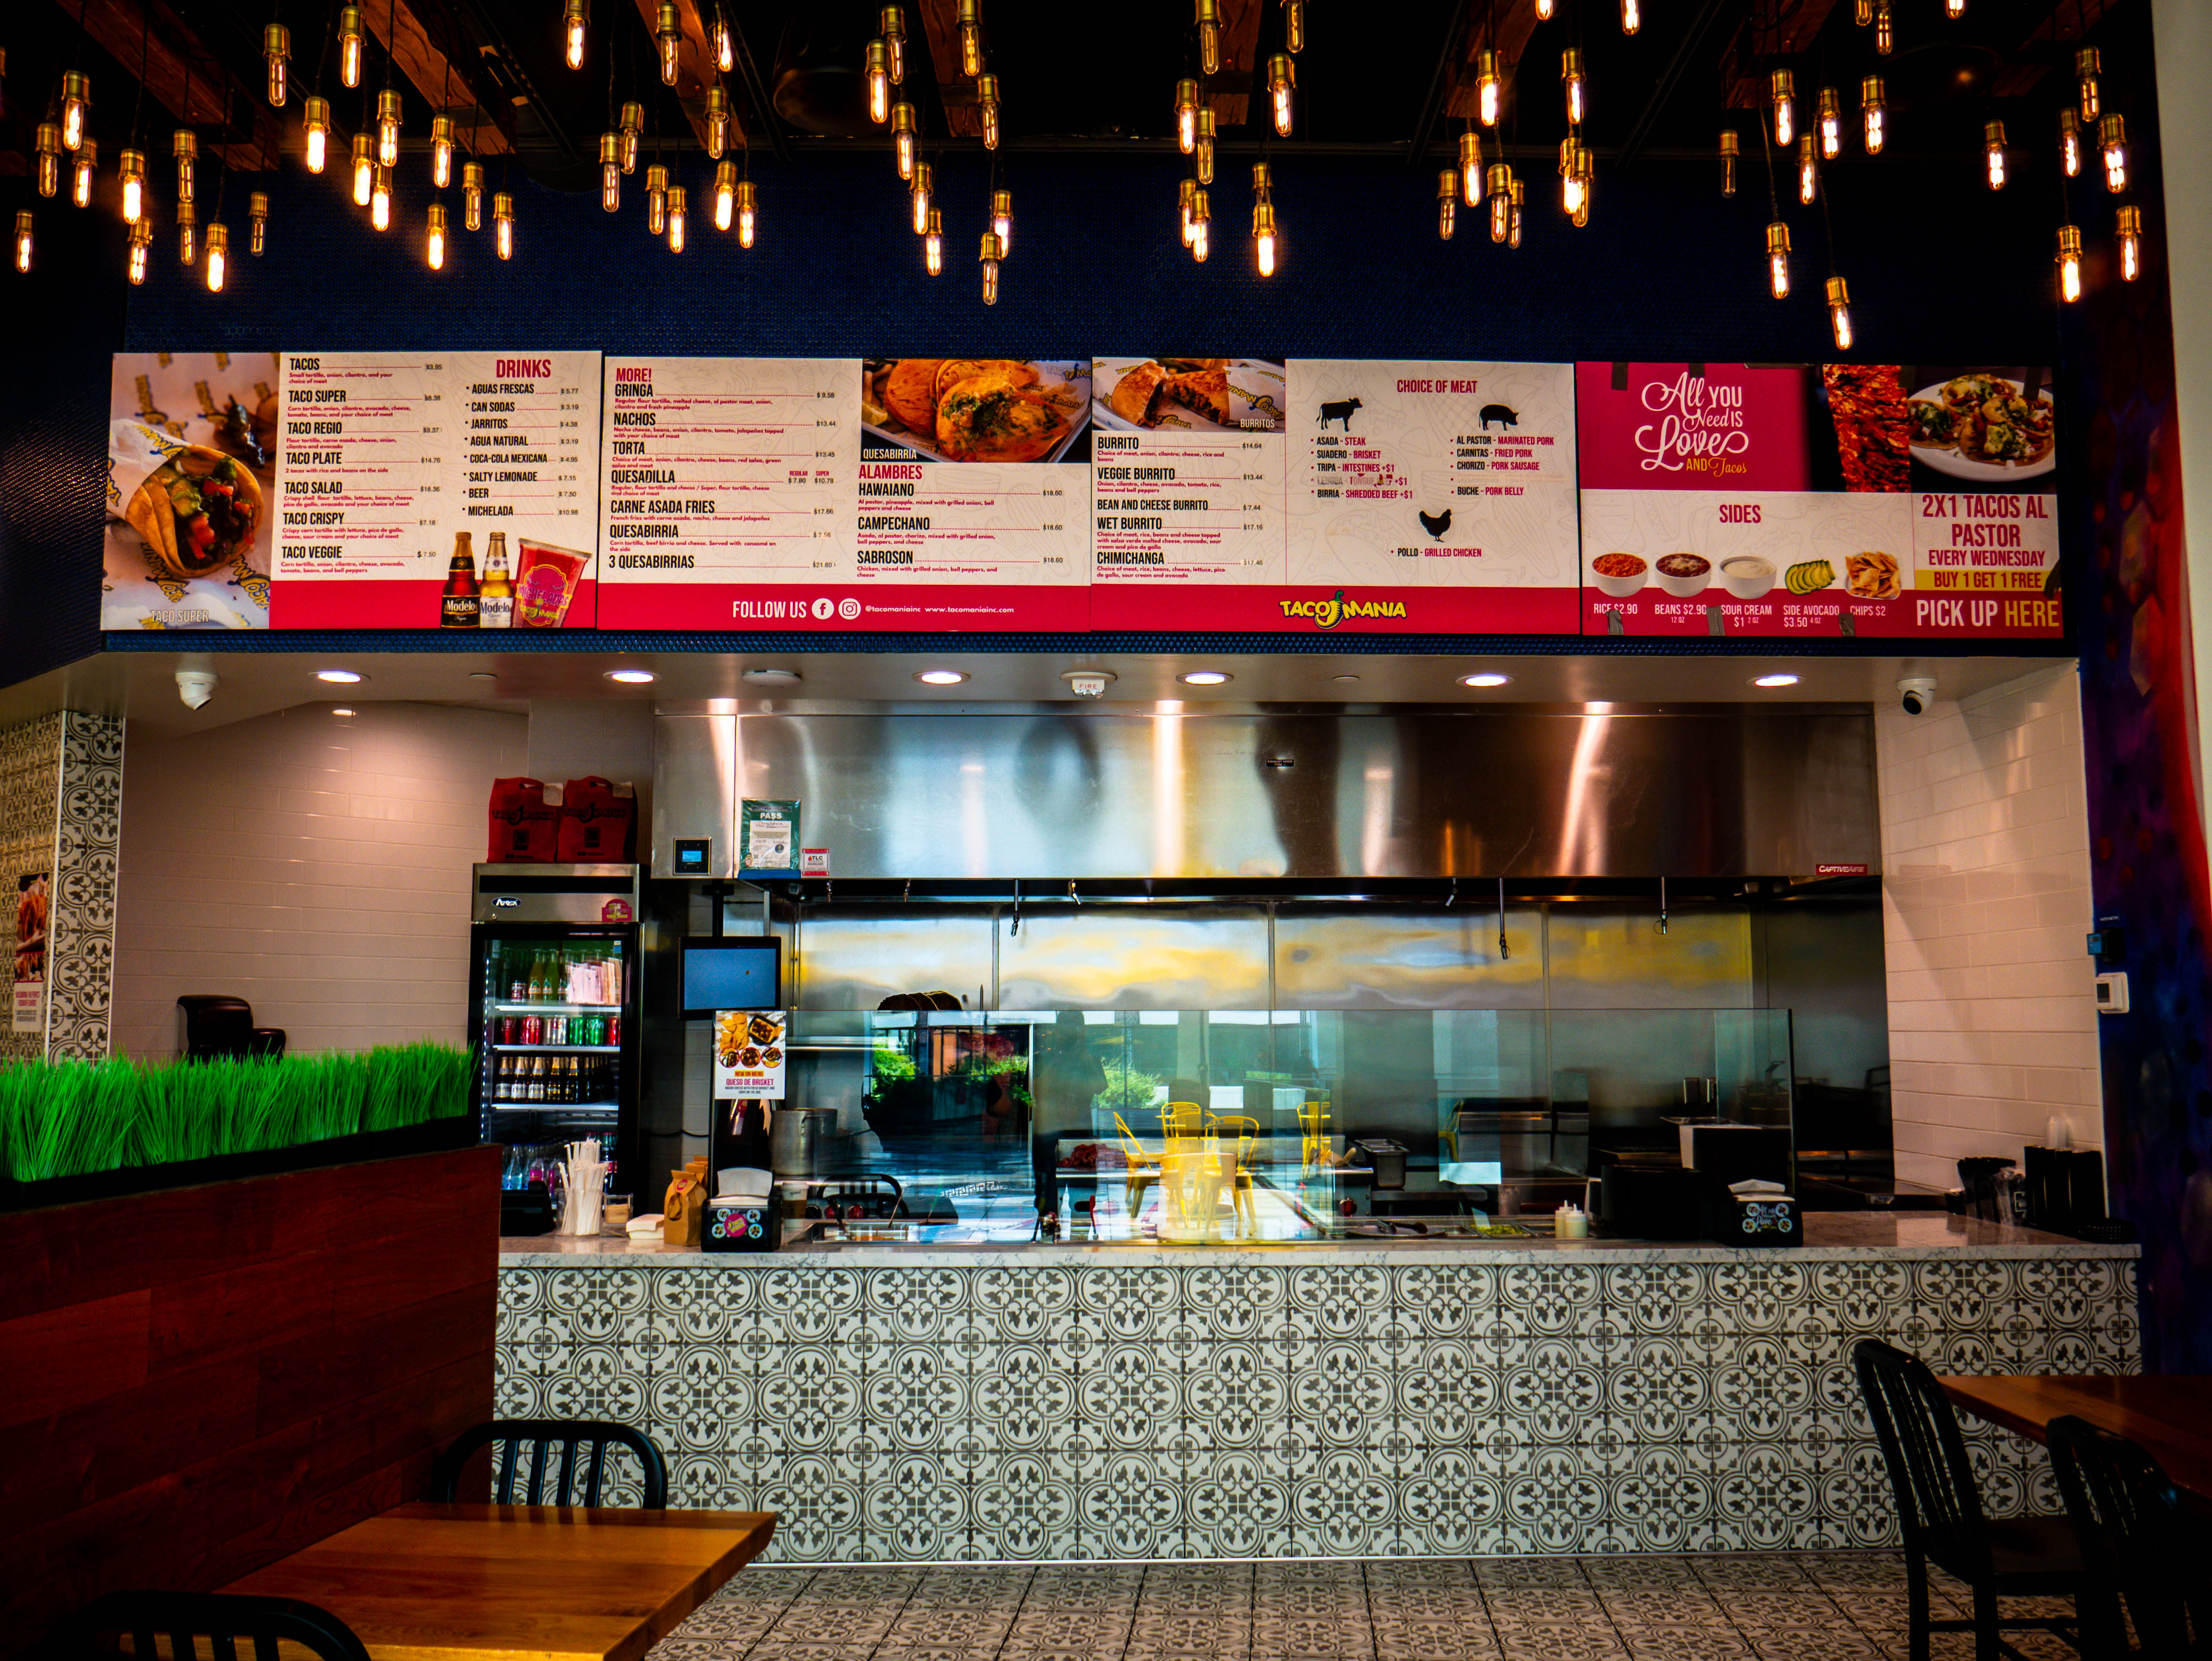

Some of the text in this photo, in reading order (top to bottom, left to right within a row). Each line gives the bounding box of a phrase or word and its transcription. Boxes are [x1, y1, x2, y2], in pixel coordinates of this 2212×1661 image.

[289, 358, 319, 370] TACOS
[496, 359, 551, 378] DRINKS
[616, 368, 652, 382] MORE!
[472, 384, 534, 394] AGUAS FRESCAS
[615, 384, 653, 397] GRINGA
[1397, 380, 1477, 393] CHOICE OF MEAT
[288, 390, 346, 402] TACO SUPER
[1641, 371, 1742, 418] All YOU
[471, 419, 508, 429] JARRITOS
[614, 413, 656, 426] NACHOS
[1240, 419, 1275, 428] BURRITOS
[1683, 408, 1742, 431] Need IS
[287, 422, 342, 434] TACO REGIO
[1098, 437, 1139, 449] BURRITO
[1317, 437, 1366, 446] ASADA STEAK
[1457, 436, 1554, 446] AL PASTOR MARINATED PORK
[1635, 415, 1749, 471] Love
[613, 441, 645, 455] TORTA
[863, 449, 917, 459] QUESABIRRIA
[1457, 449, 1532, 458] CARNITAS FRIED PORK
[286, 452, 342, 464] TACO PLATE
[470, 454, 547, 463] COCA-COLA MEXICANA
[859, 465, 922, 479] ALAMBRES
[1686, 457, 1747, 477] AND Tacos
[611, 470, 675, 483] QUESADILLA
[469, 488, 489, 498] BEER
[859, 483, 914, 496] HAWAIANO
[468, 506, 513, 516] MICHELADA
[611, 500, 715, 513] CARNE ASADA FRIES
[1097, 499, 1208, 511] BEAN AND CHEESE BURRITO
[1923, 495, 2048, 518] 2X1 TACOS AL
[1719, 504, 1761, 523] SIDES
[858, 517, 930, 530] CAMPECHANO
[610, 525, 679, 538] QUESABIRRIA
[1952, 524, 2021, 547] PASTOR
[282, 546, 342, 558] TACO VEGGIE
[857, 550, 913, 564] SABROSON
[1097, 552, 1164, 564] CHIMICHANGA
[1398, 548, 1481, 557] POLLO GRILLED CHICKEN
[1928, 550, 2045, 566] EVERY WEDNESDAY
[1934, 572, 2042, 588] BUY 1 GET 1 FREE
[447, 600, 475, 611] Modelo
[479, 602, 509, 613] Modelo
[733, 601, 786, 618] FOLLOW
[790, 601, 807, 618] US
[1279, 600, 1406, 619] TACO MANIA
[1594, 604, 1638, 614] RICE $2.90
[1655, 605, 1706, 615] BEANS $2.90
[1721, 605, 1772, 615] SOUR CREAM
[1783, 606, 1840, 616] SIDE AVOCADO
[1850, 606, 1886, 616] CHIPS $2
[151, 610, 209, 623] TACO SUPER
[1917, 600, 2059, 626] PICK UP HERE
[1734, 617, 1744, 627] $1
[1784, 617, 1807, 628] $3.50
